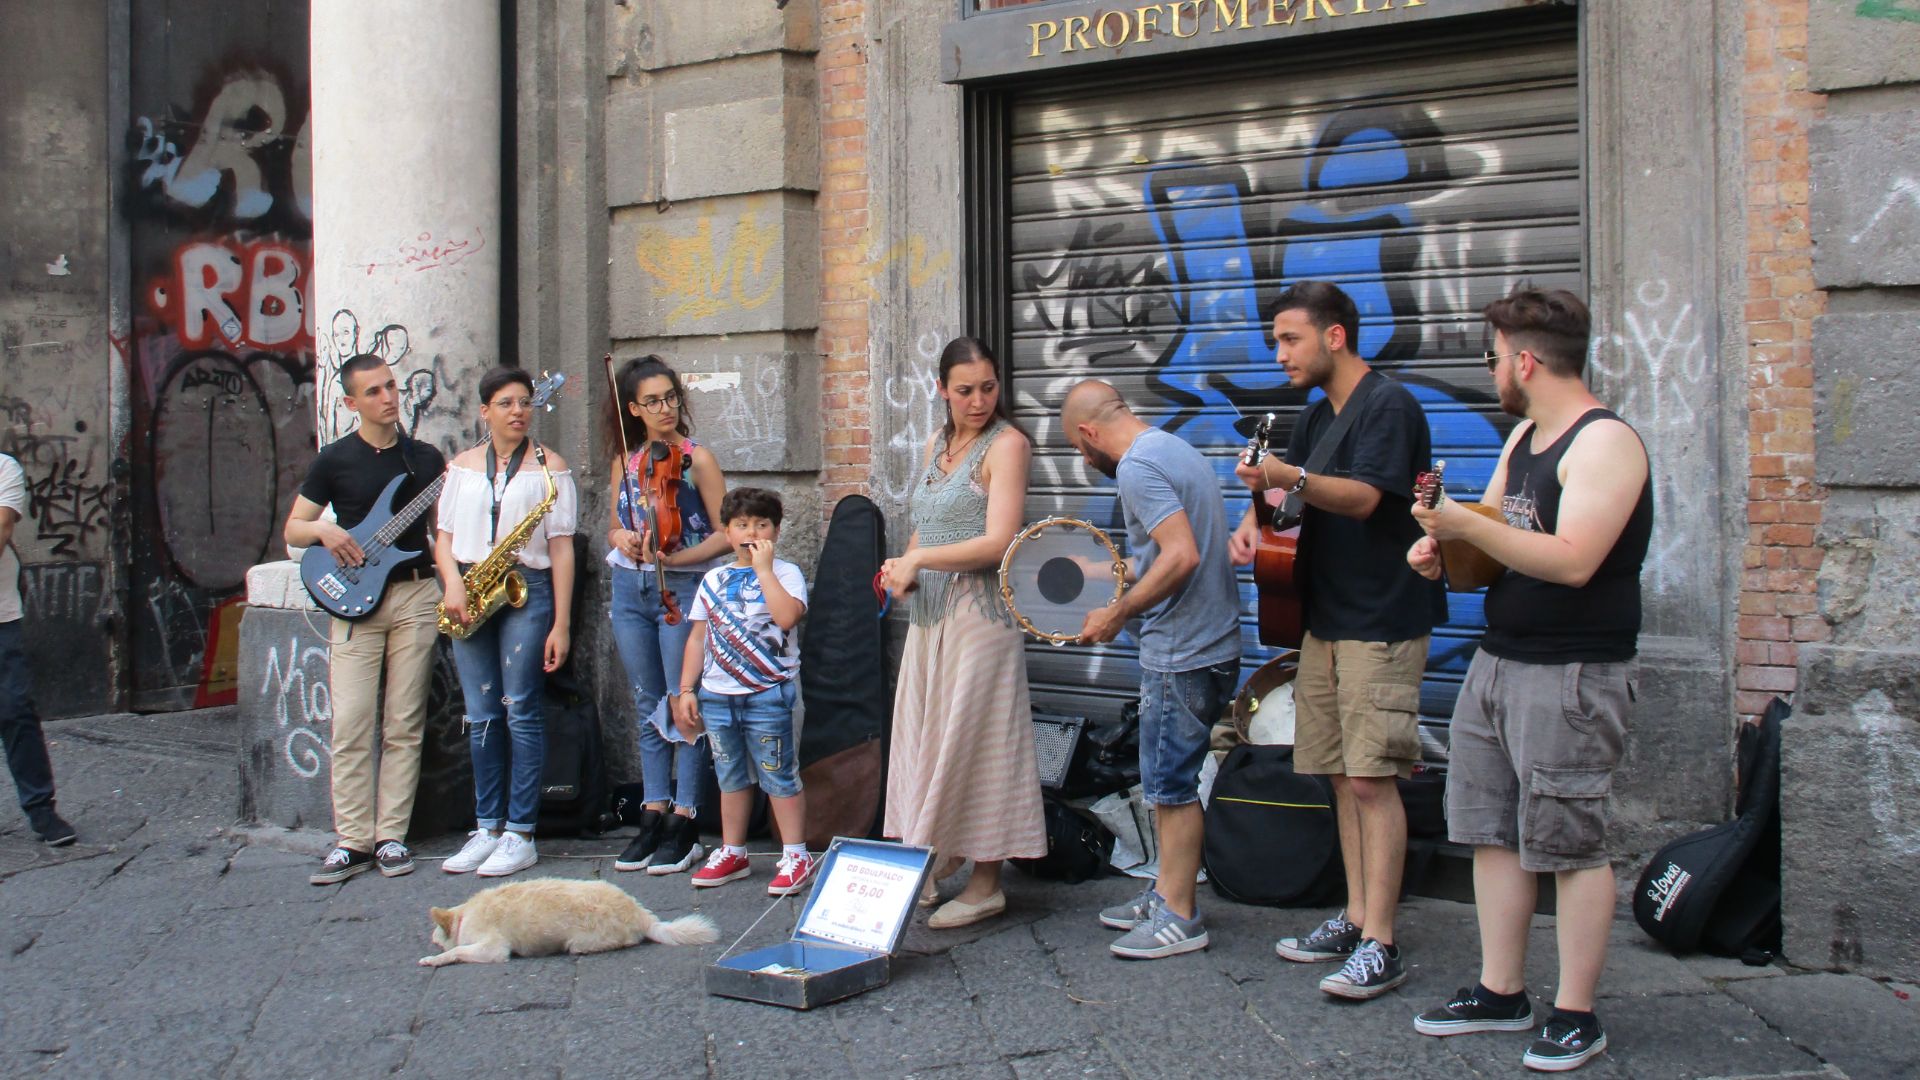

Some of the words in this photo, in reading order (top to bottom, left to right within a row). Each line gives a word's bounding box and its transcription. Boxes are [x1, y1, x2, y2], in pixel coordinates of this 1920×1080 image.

[760, 733, 783, 771] 3
[846, 864, 858, 873] CD
[858, 884, 885, 899] 5,00
